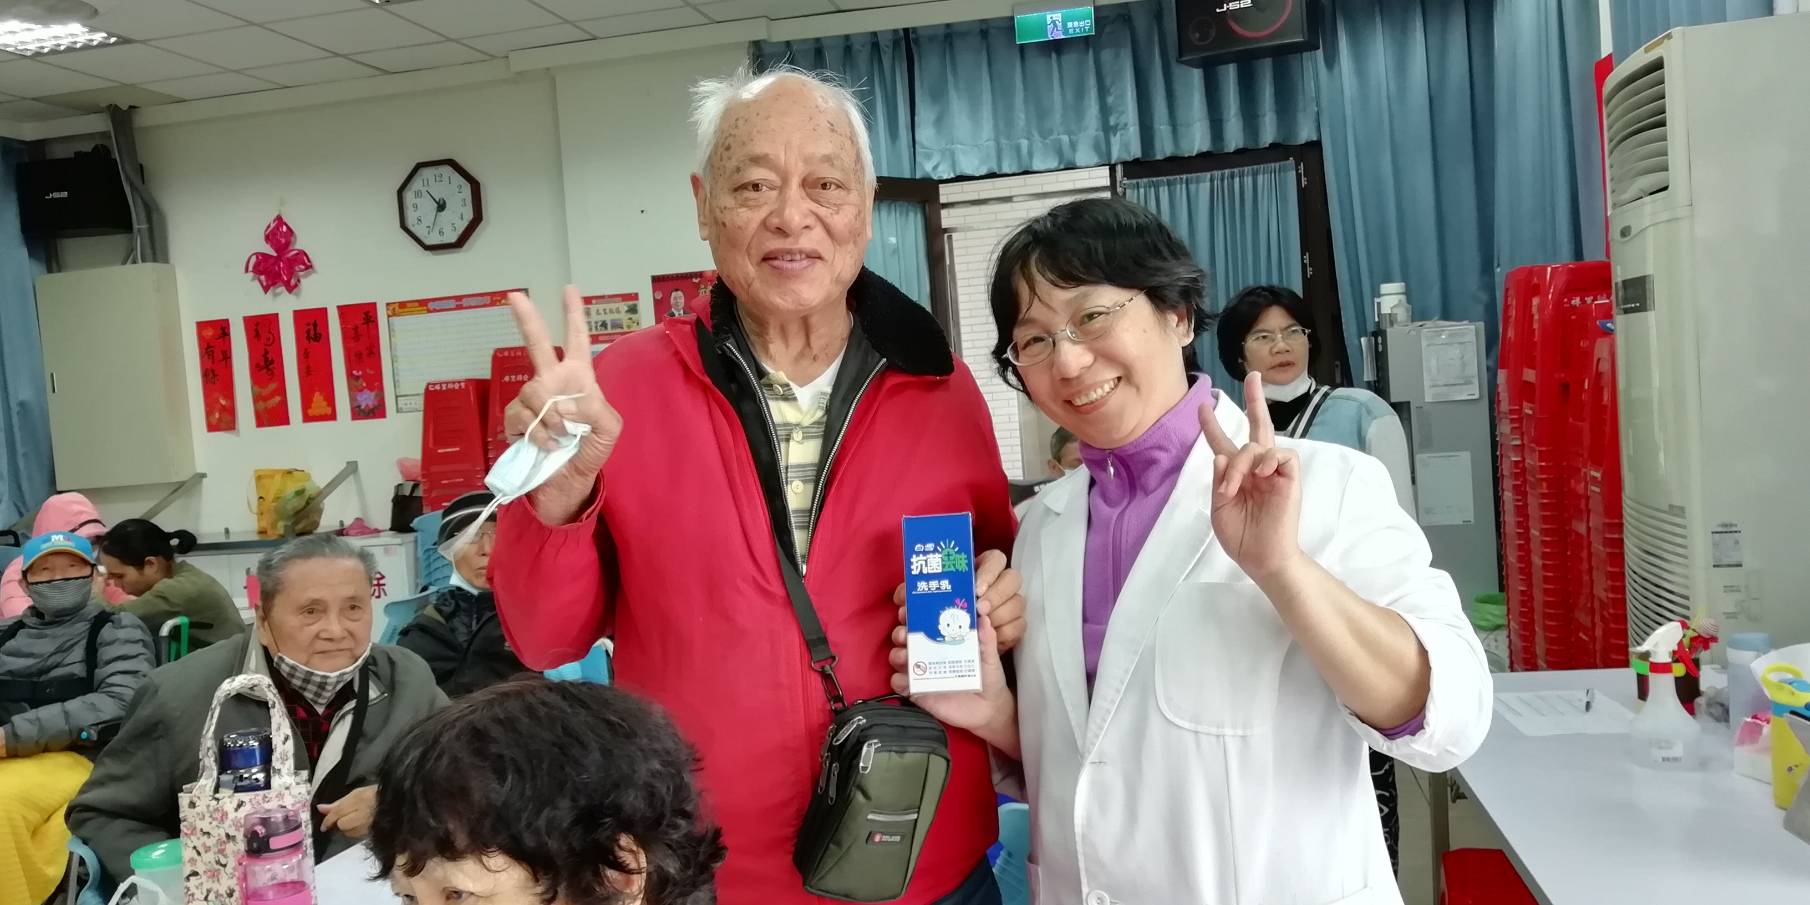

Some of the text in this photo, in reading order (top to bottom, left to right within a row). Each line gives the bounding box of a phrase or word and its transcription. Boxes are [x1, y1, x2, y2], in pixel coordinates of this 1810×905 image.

[1068, 26, 1089, 34] EXIT
[422, 178, 430, 187] 11
[434, 173, 443, 183] 12
[448, 175, 451, 185] 1
[413, 189, 423, 199] 10
[457, 184, 462, 194] 2
[412, 202, 418, 212] 9
[461, 198, 466, 207] 3
[416, 215, 422, 225] 8
[459, 212, 464, 221] 4
[425, 225, 431, 235] 7
[438, 227, 445, 237] 6
[451, 222, 457, 232] 5
[910, 549, 969, 575] 抗菌去味
[917, 579, 952, 592] 洗手乳
